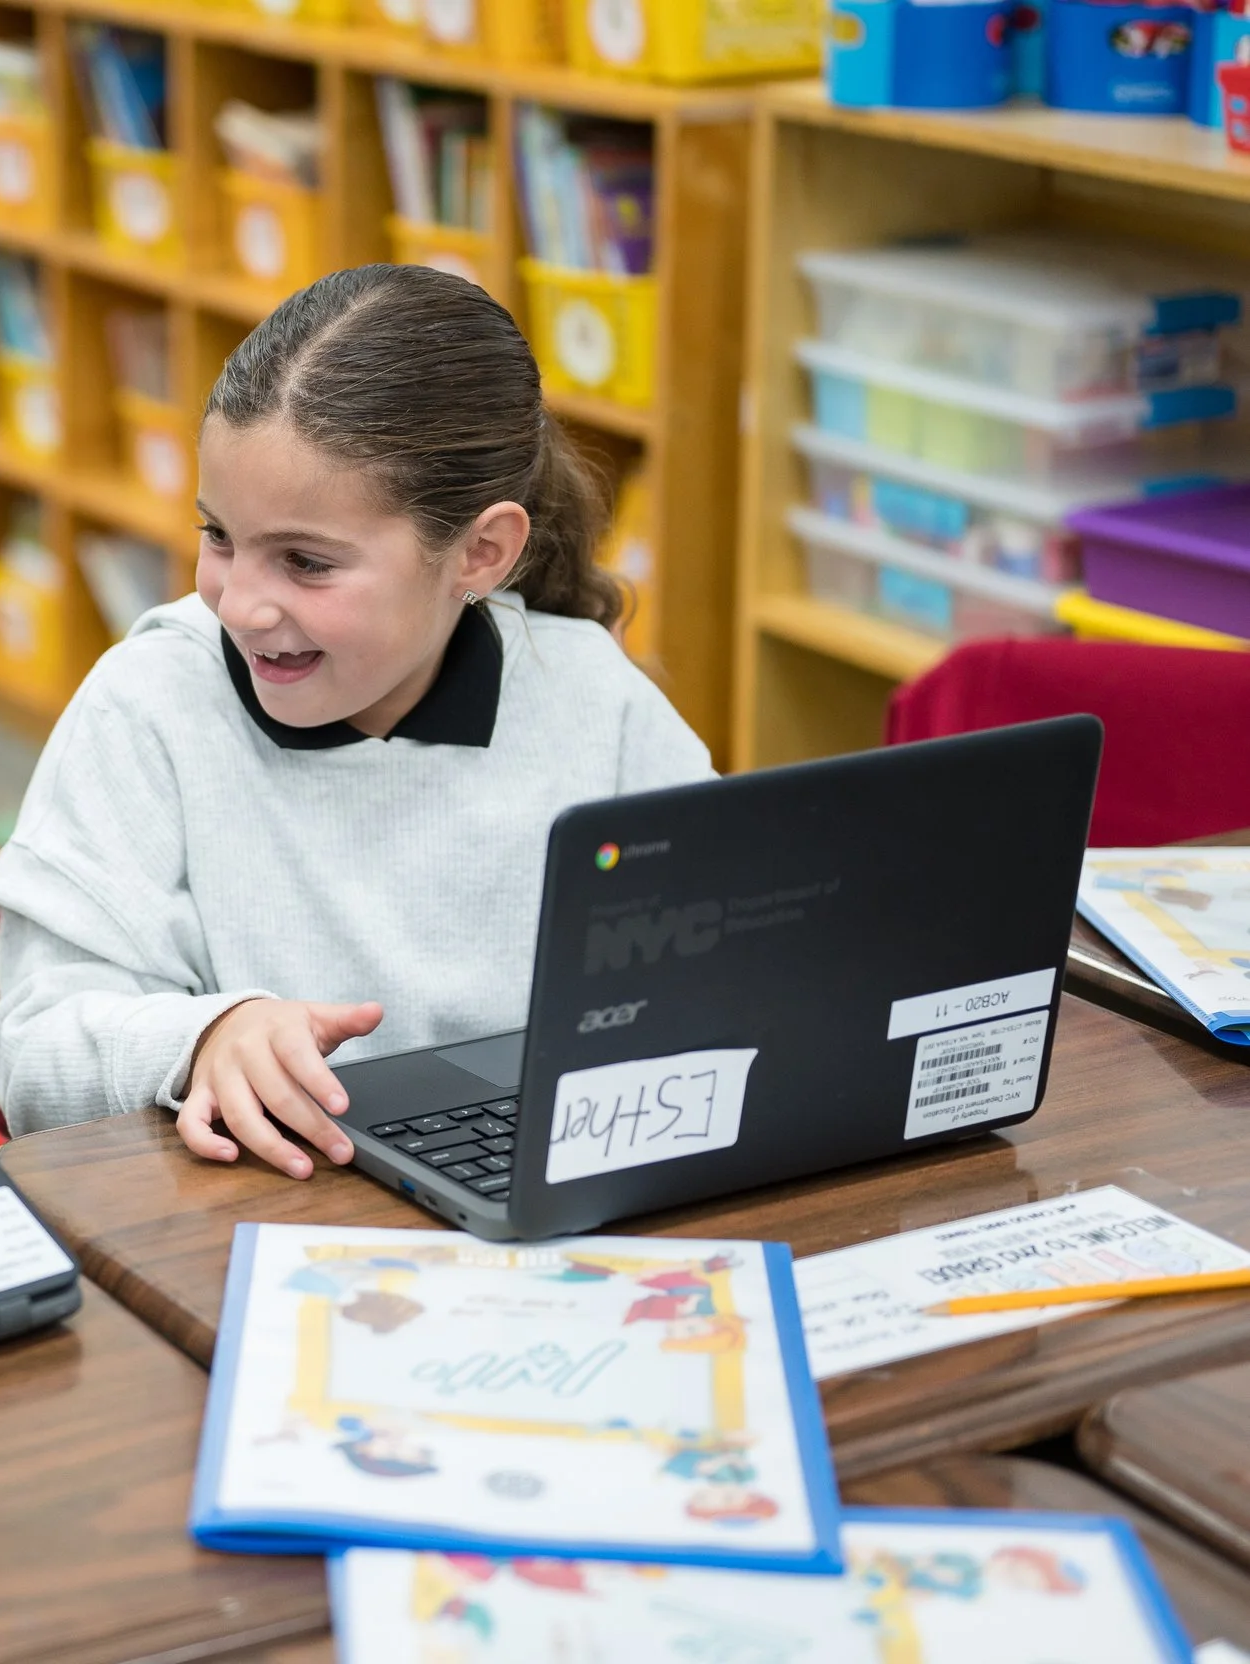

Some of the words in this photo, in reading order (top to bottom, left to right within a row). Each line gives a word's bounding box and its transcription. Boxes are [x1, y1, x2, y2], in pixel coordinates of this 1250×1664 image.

[621, 840, 670, 857] chrome
[585, 902, 723, 976] NYC
[936, 1004, 949, 1018] 11
[965, 990, 1011, 1012] ACB20
[577, 999, 649, 1033] acer
[1004, 1091, 1021, 1102] NYC
[1069, 1214, 1179, 1248] WELCOME
